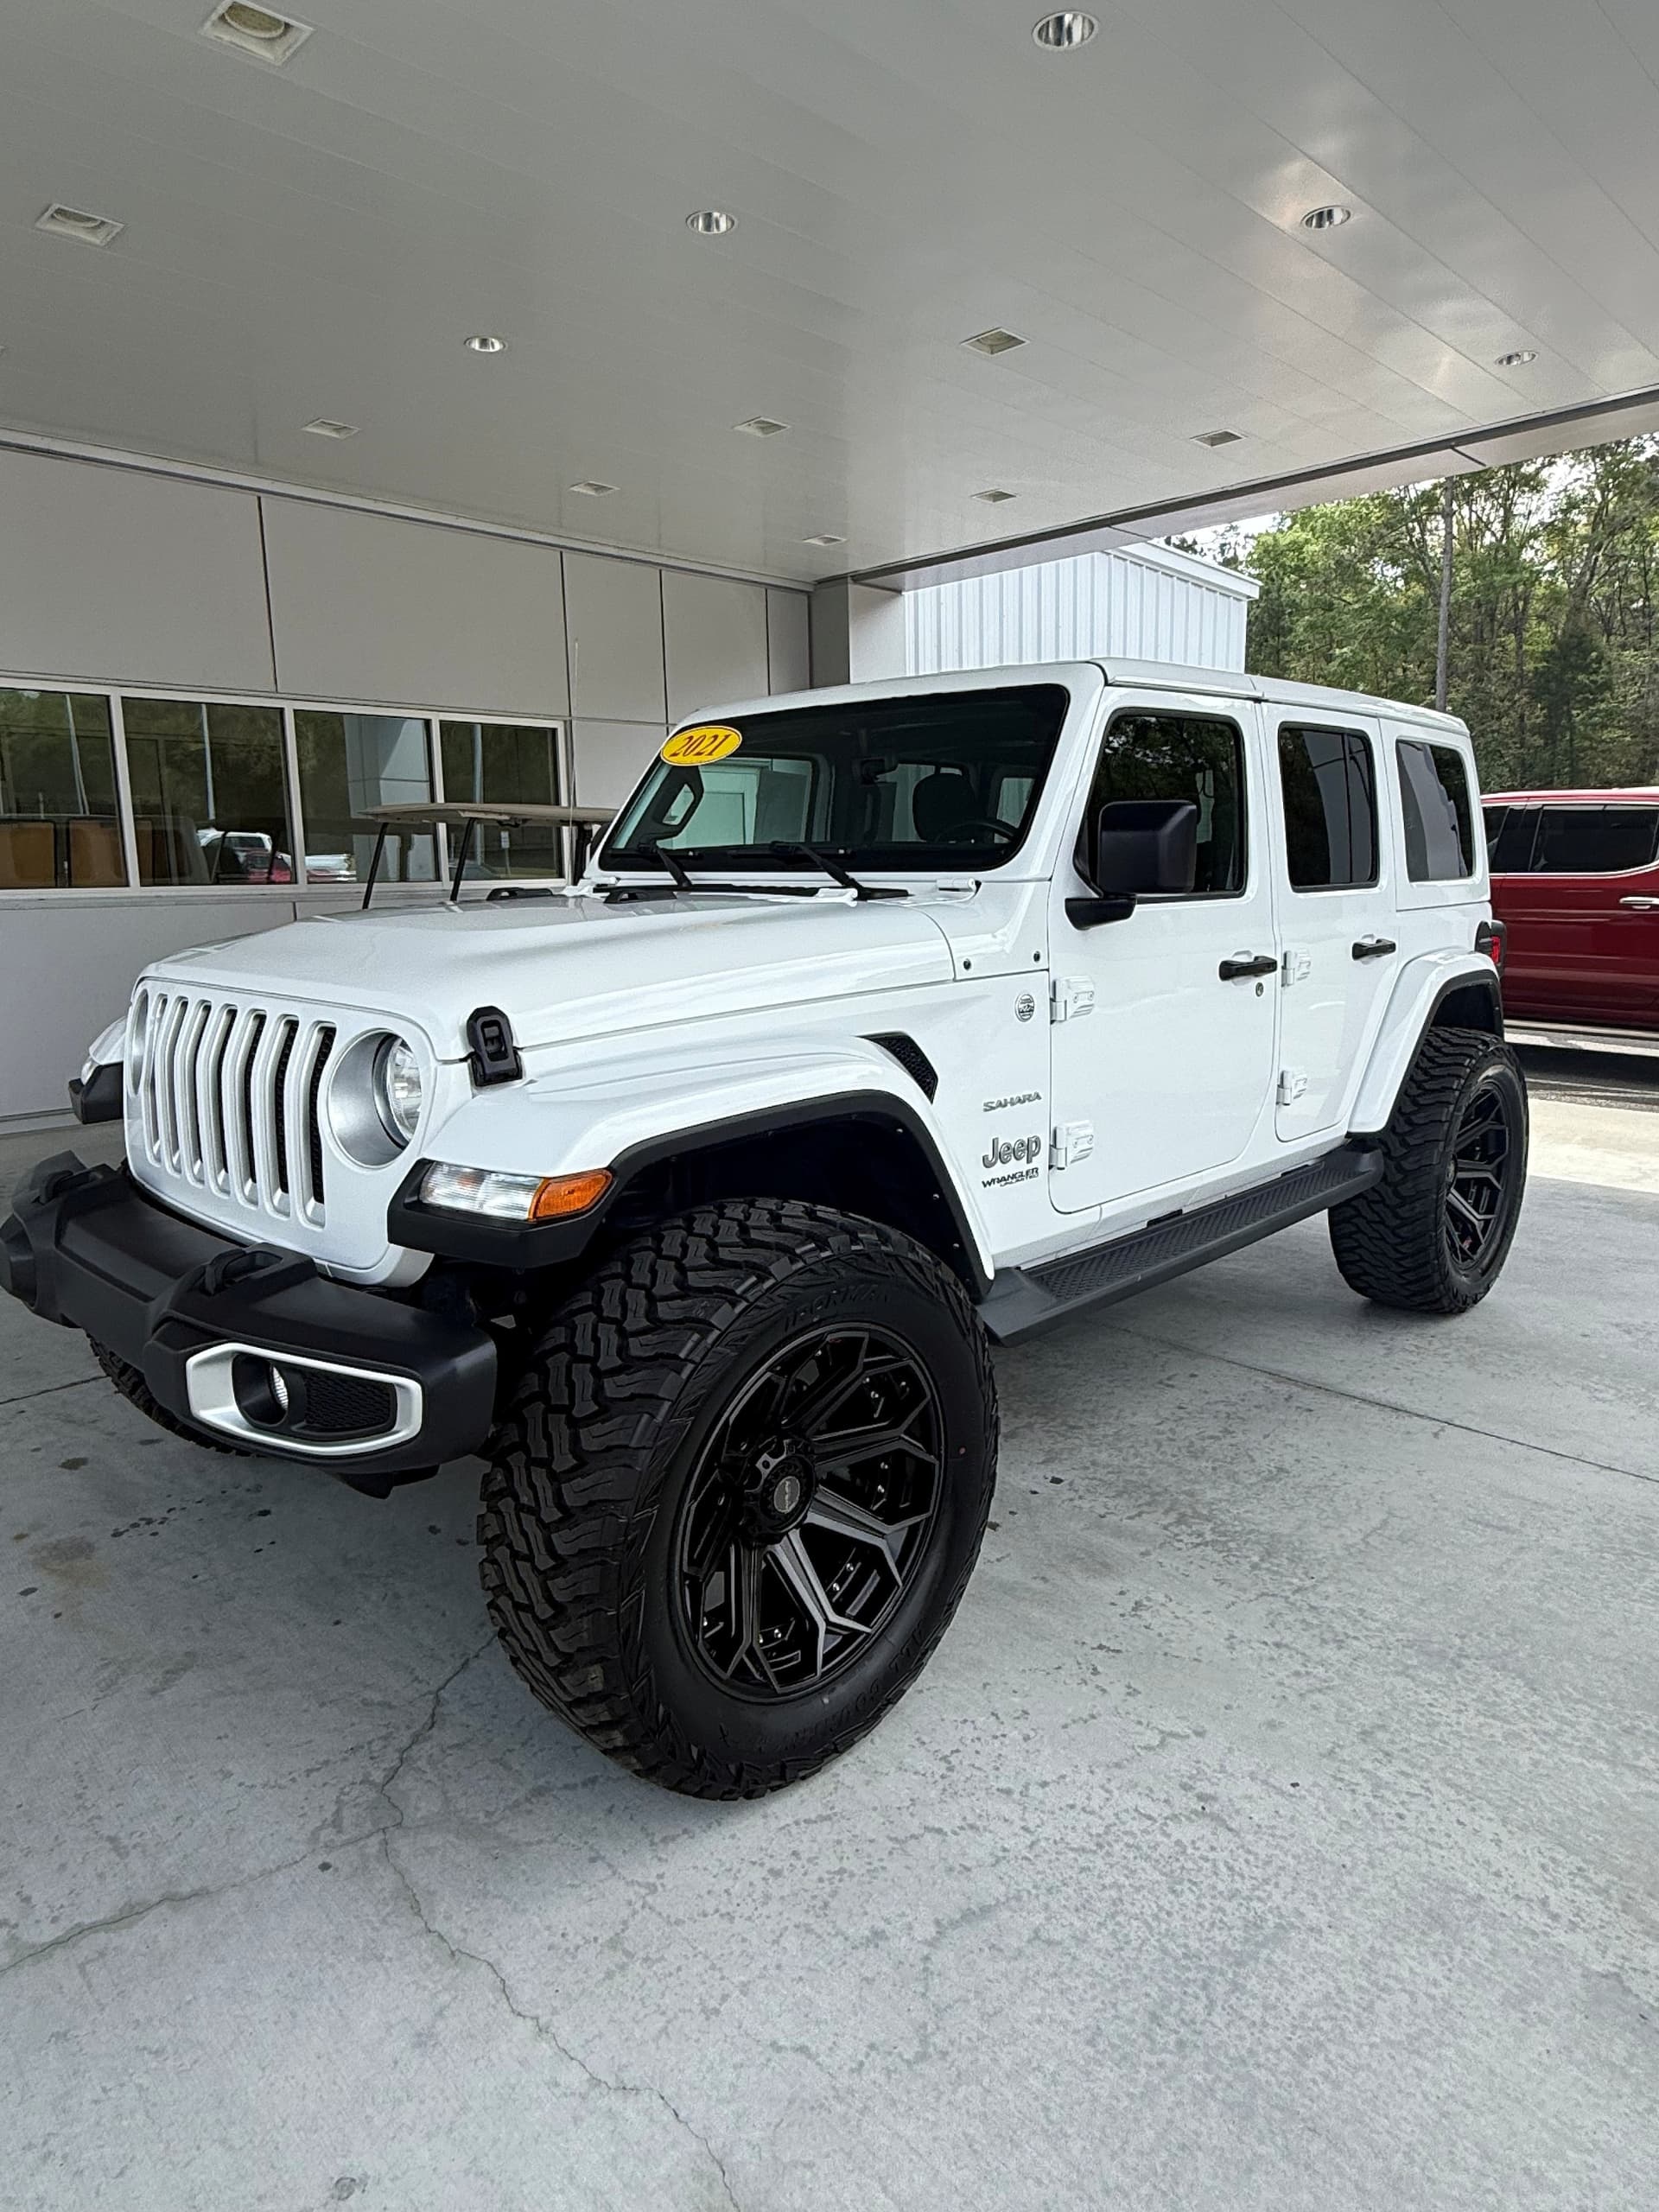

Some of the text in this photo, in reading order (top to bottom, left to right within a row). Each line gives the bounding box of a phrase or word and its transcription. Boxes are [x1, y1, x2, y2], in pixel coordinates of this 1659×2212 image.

[669, 734, 732, 757] 2021
[982, 1091, 1042, 1112] SAHARA
[982, 1135, 1041, 1168] Jeep
[982, 1167, 1039, 1188] WRANGLER
